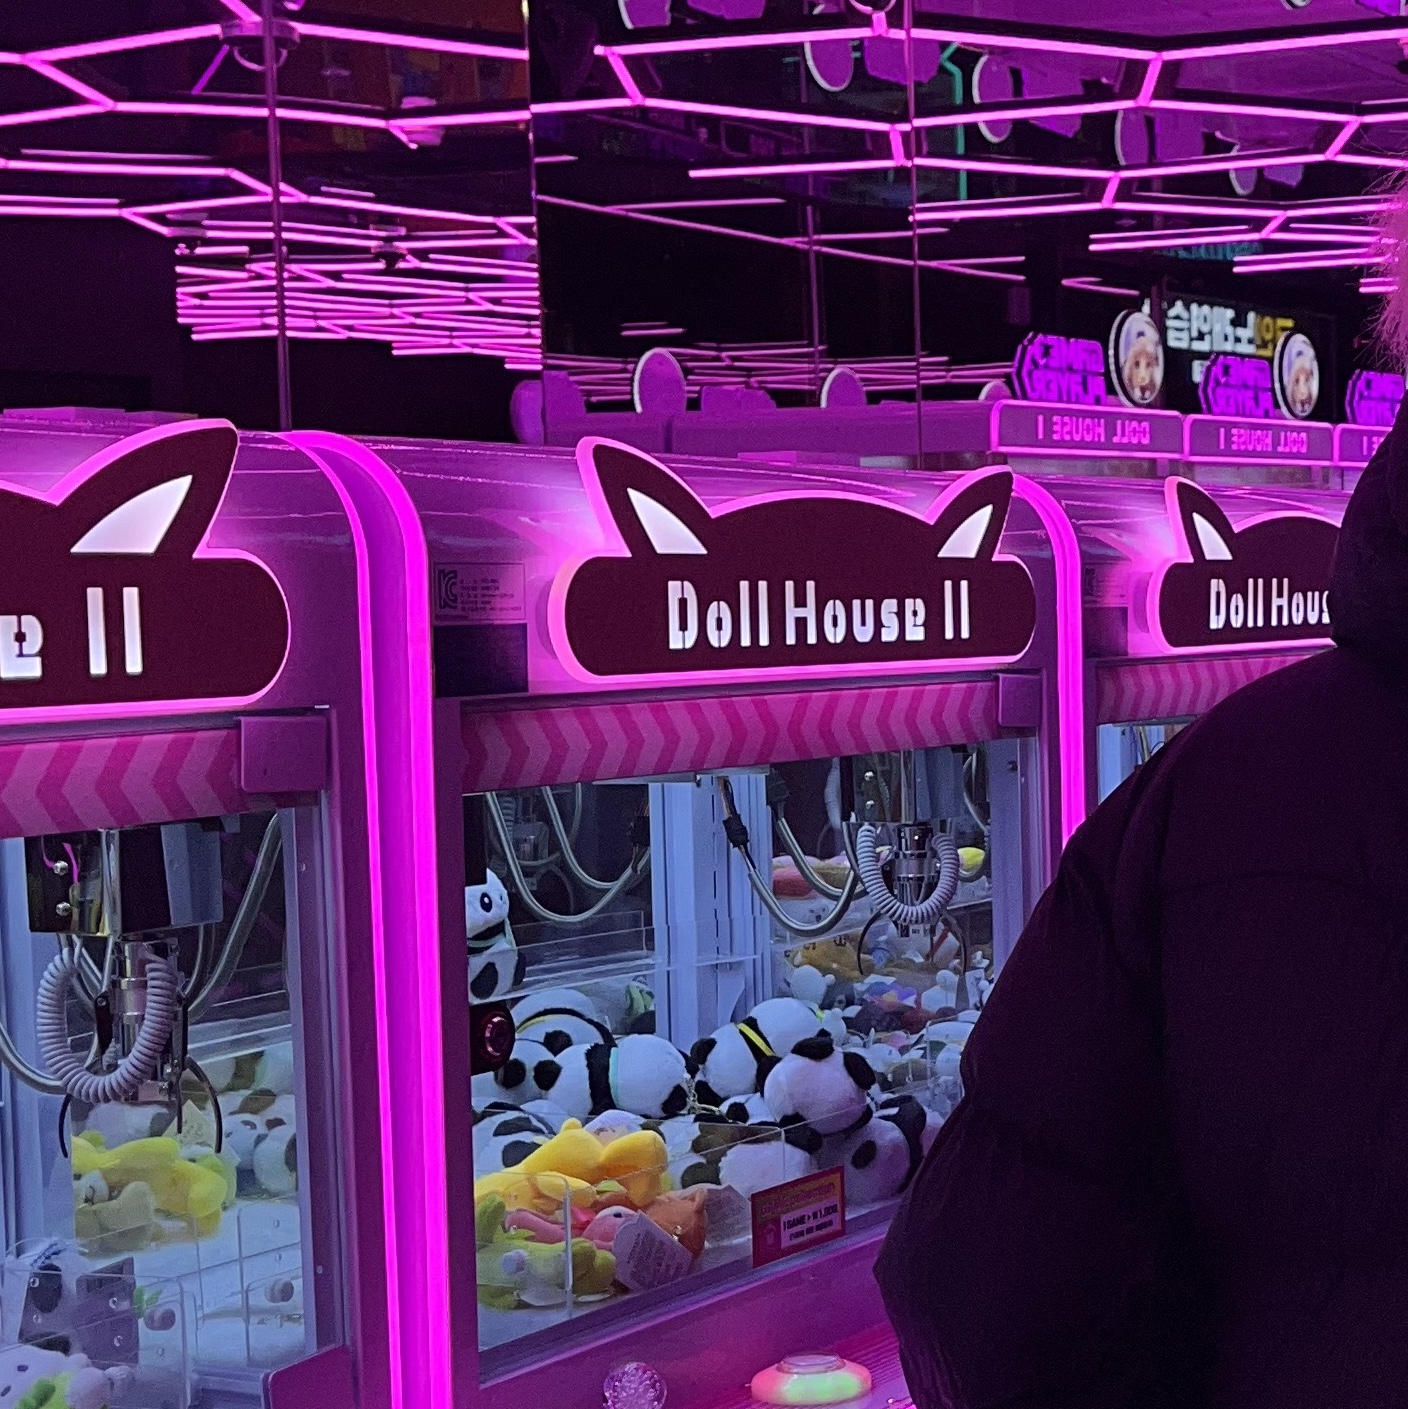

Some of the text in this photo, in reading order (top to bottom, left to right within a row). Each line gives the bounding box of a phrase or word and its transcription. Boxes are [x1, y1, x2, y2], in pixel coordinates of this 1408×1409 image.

[667, 580, 770, 650] Doll
[784, 580, 926, 647] House
[1209, 577, 1331, 630] Doll Hous
